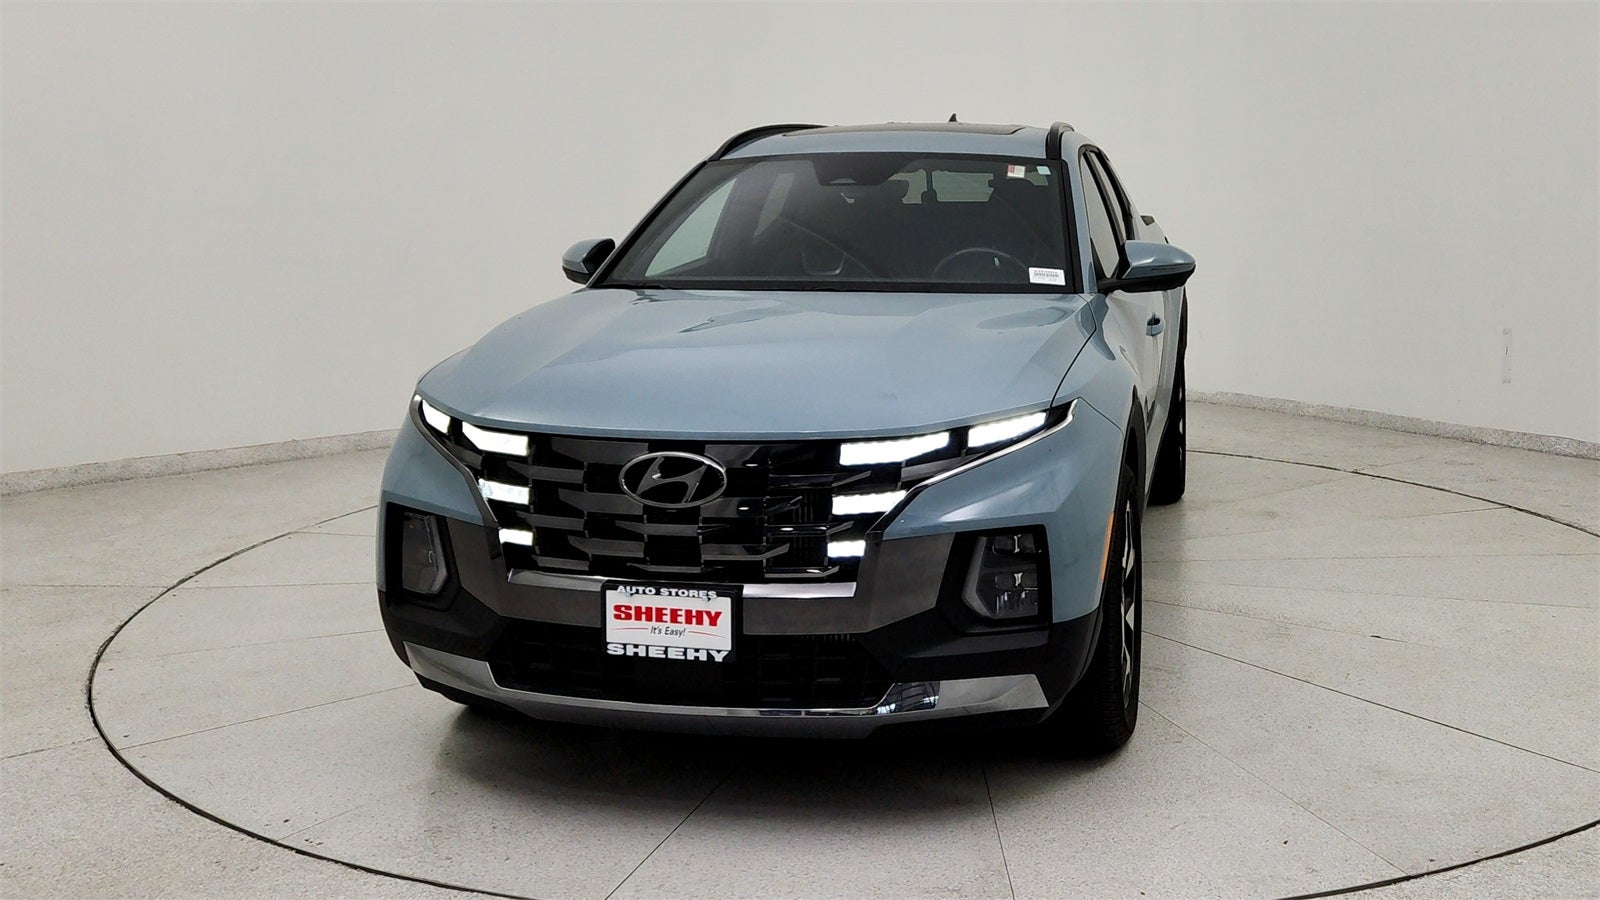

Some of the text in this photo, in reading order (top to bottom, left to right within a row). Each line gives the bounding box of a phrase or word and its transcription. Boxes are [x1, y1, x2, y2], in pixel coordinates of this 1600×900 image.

[616, 585, 717, 599] AUTO STORES
[613, 604, 722, 627] SHEEHY
[650, 626, 686, 638] It's Easy!
[606, 643, 729, 662] SHEEHY
